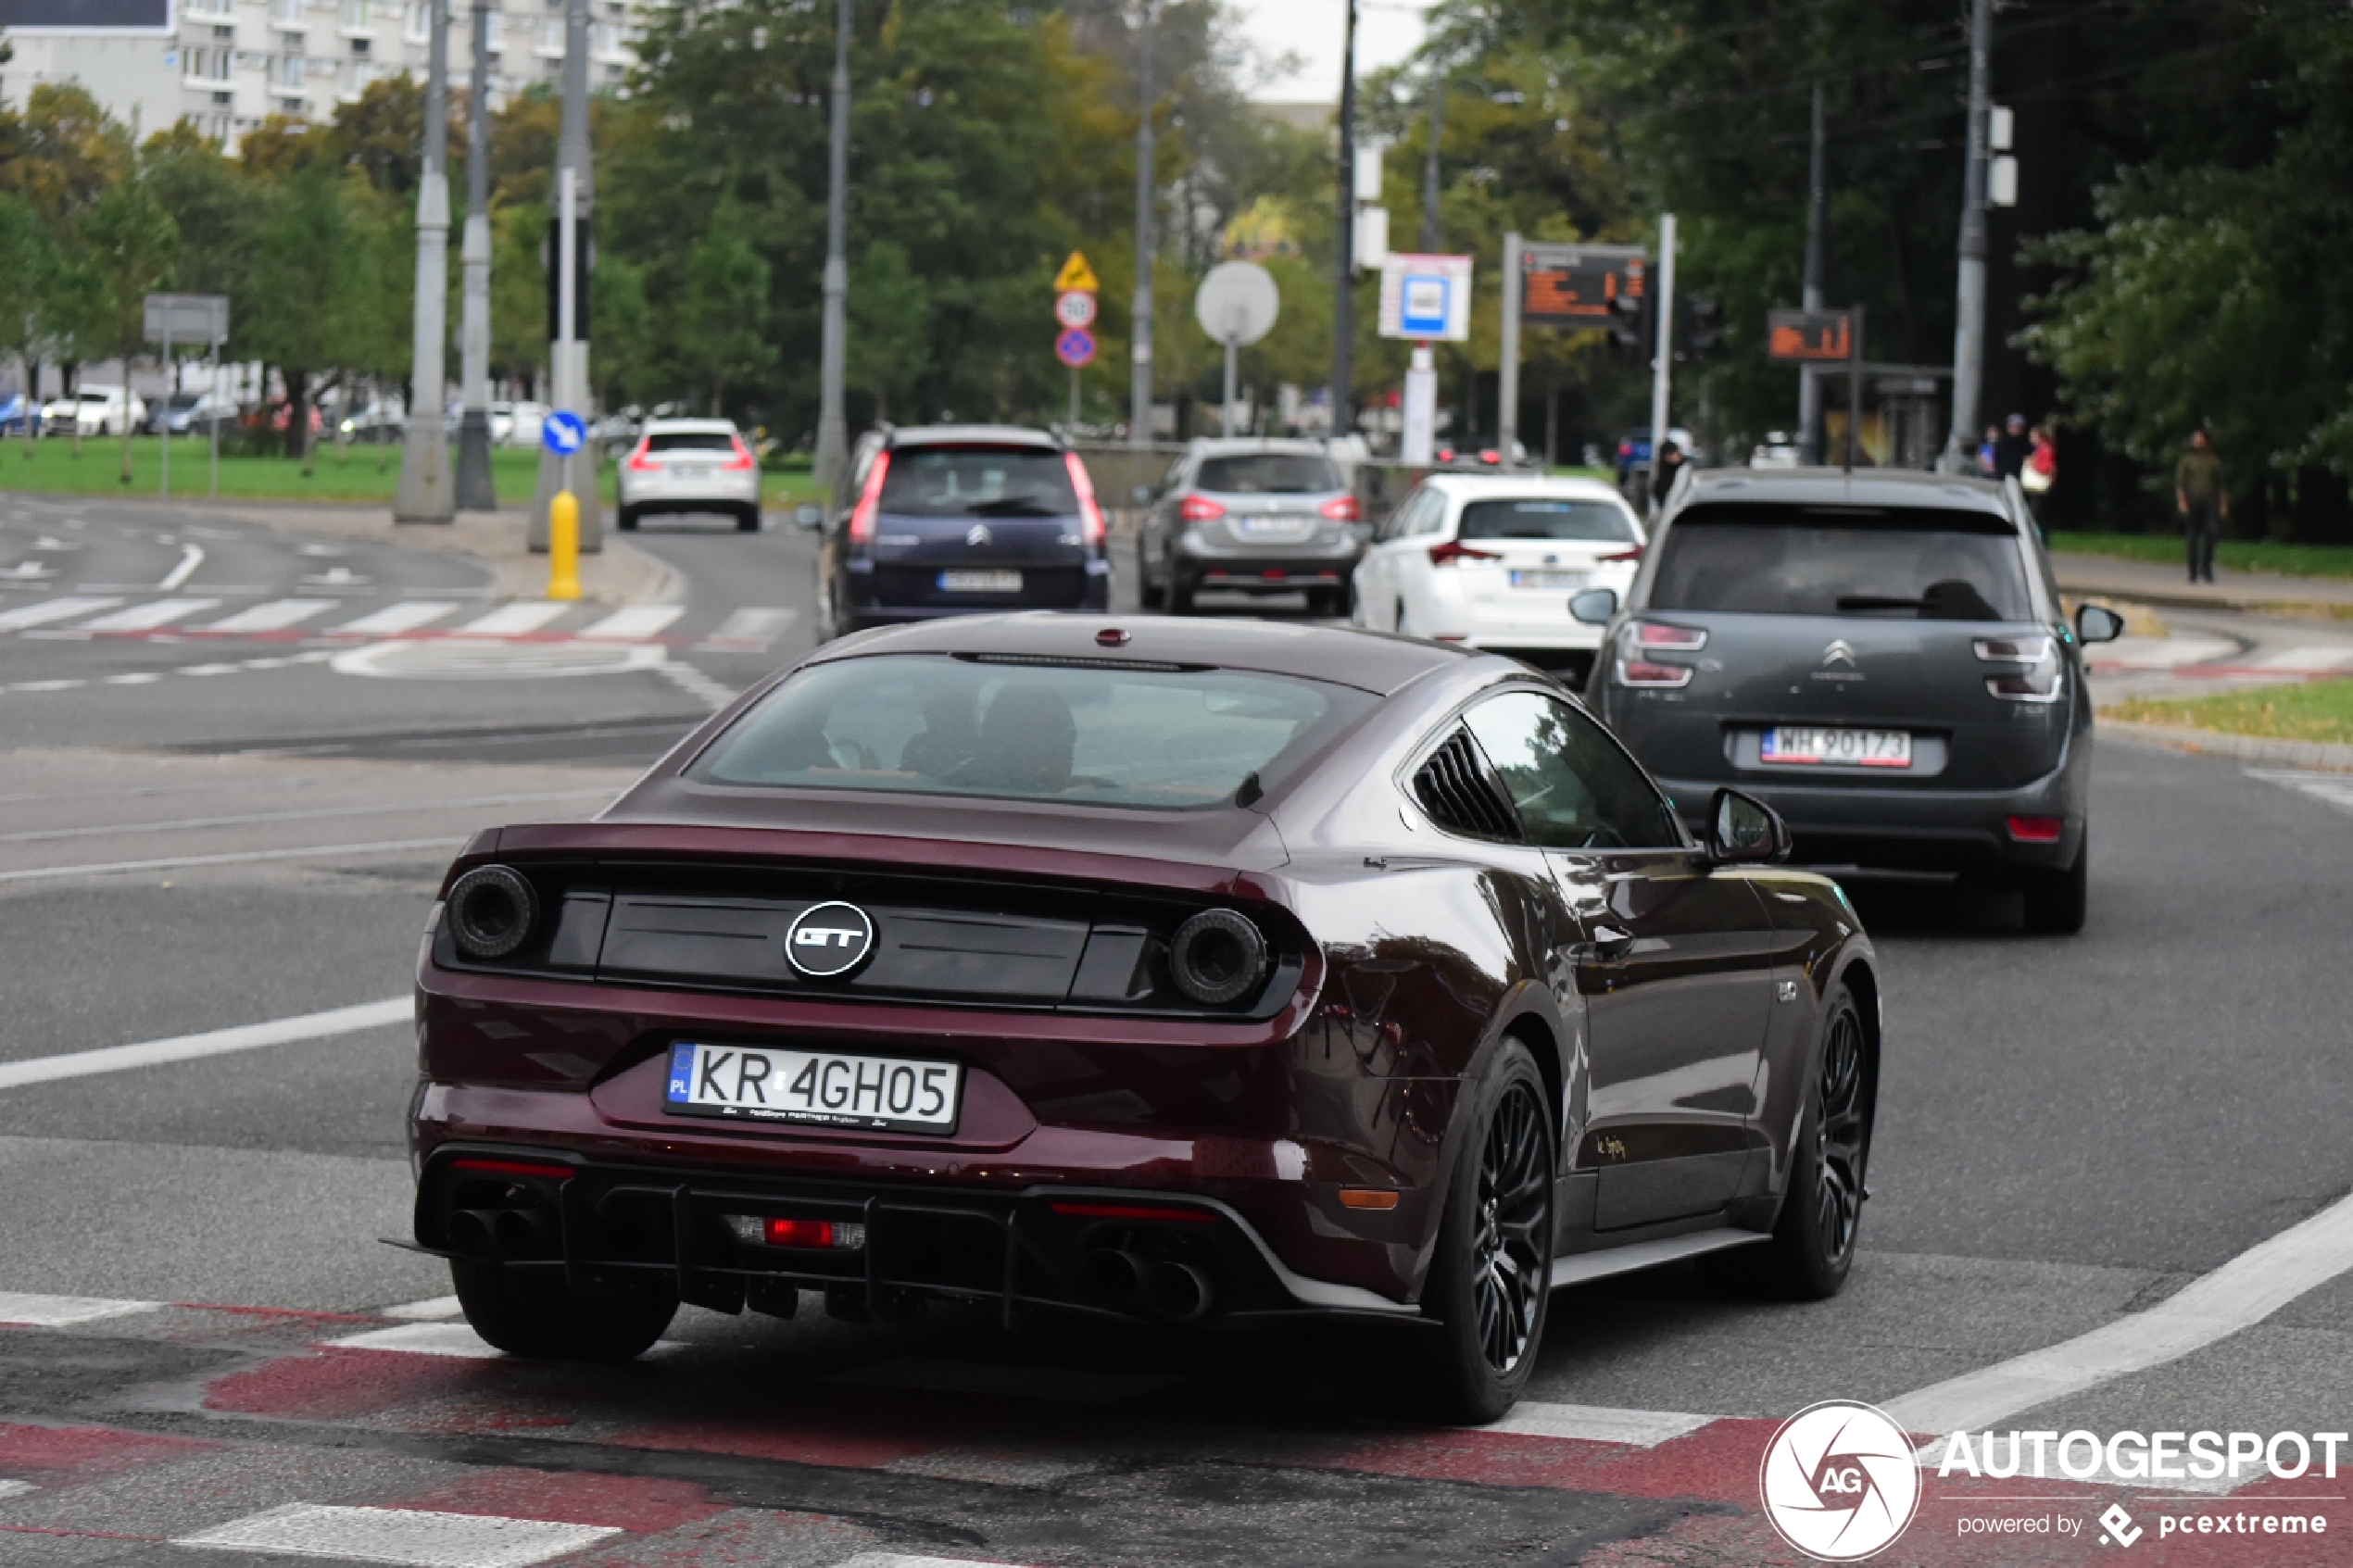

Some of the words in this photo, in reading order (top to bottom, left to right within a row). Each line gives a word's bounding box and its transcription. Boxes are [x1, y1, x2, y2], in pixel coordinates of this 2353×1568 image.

[1780, 727, 1813, 755] WH
[1823, 728, 1905, 759] 90173
[796, 928, 862, 947] GT
[670, 1079, 688, 1094] PL
[698, 1049, 772, 1104] KR
[789, 1058, 947, 1117] 4GH05
